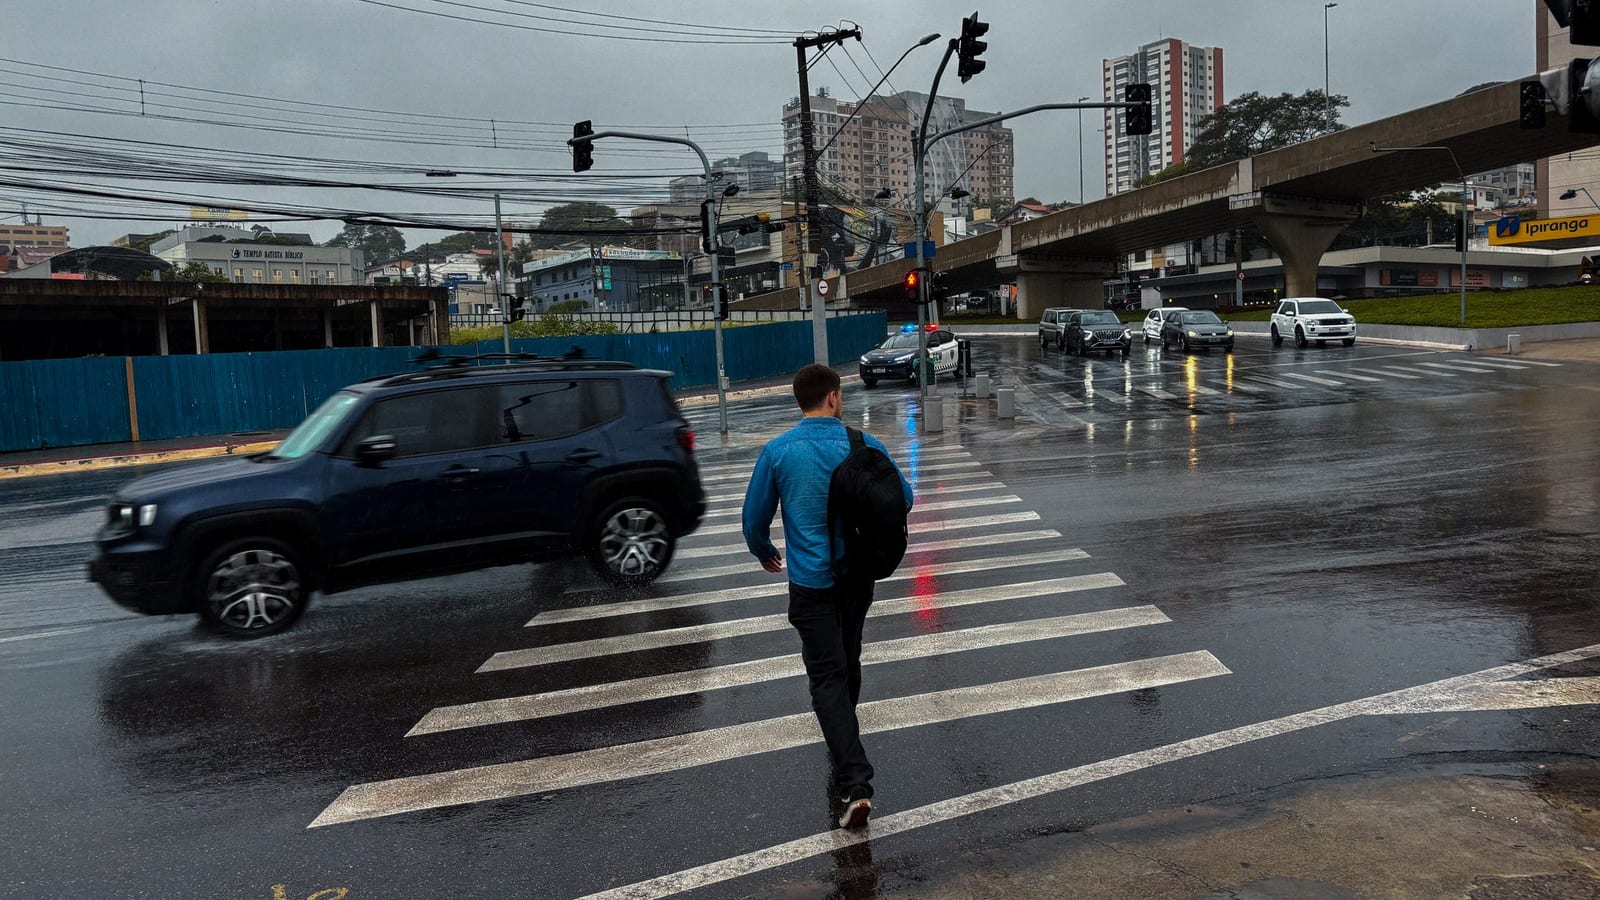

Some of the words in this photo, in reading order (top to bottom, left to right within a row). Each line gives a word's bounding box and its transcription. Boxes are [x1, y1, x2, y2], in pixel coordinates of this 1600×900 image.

[1525, 219, 1588, 236] Ipiranga
[243, 249, 262, 258] TEMPLO
[264, 250, 283, 258] BATISTA
